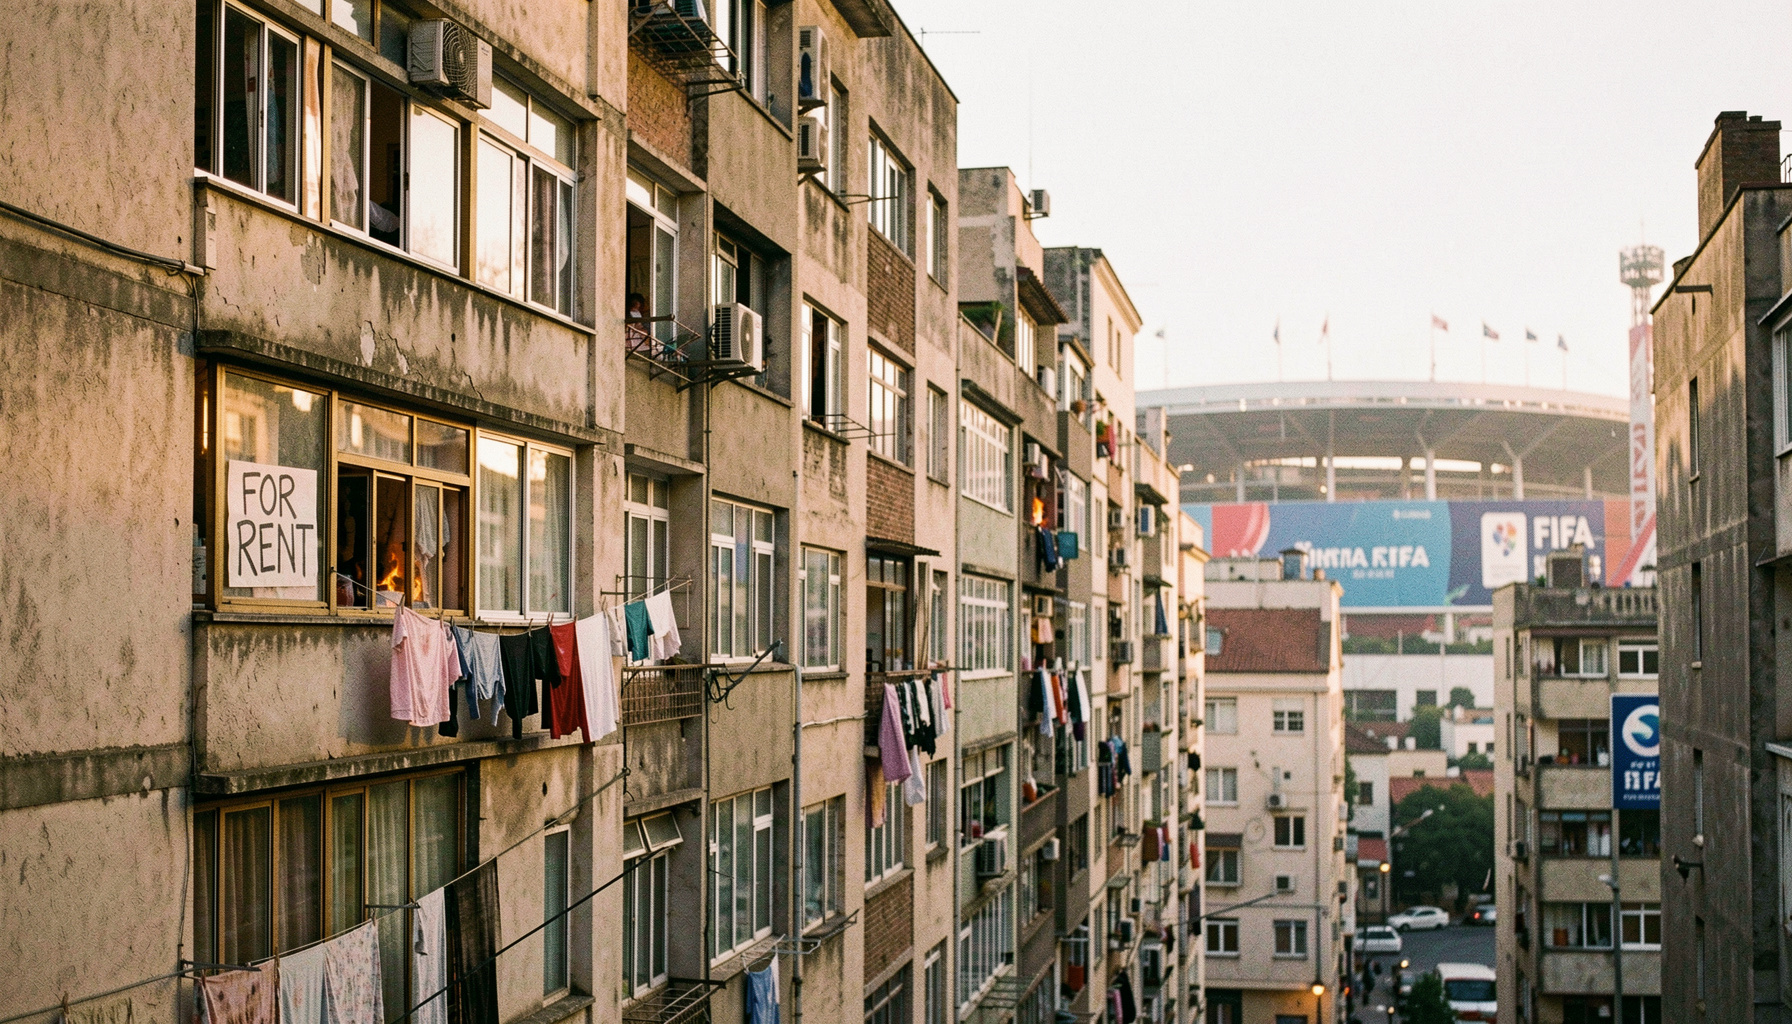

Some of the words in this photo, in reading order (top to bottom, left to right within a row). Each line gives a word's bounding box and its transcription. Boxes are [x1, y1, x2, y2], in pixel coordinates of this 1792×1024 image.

[243, 472, 297, 519] FOR
[237, 520, 314, 577] RENT
[1533, 515, 1595, 549] FIFA
